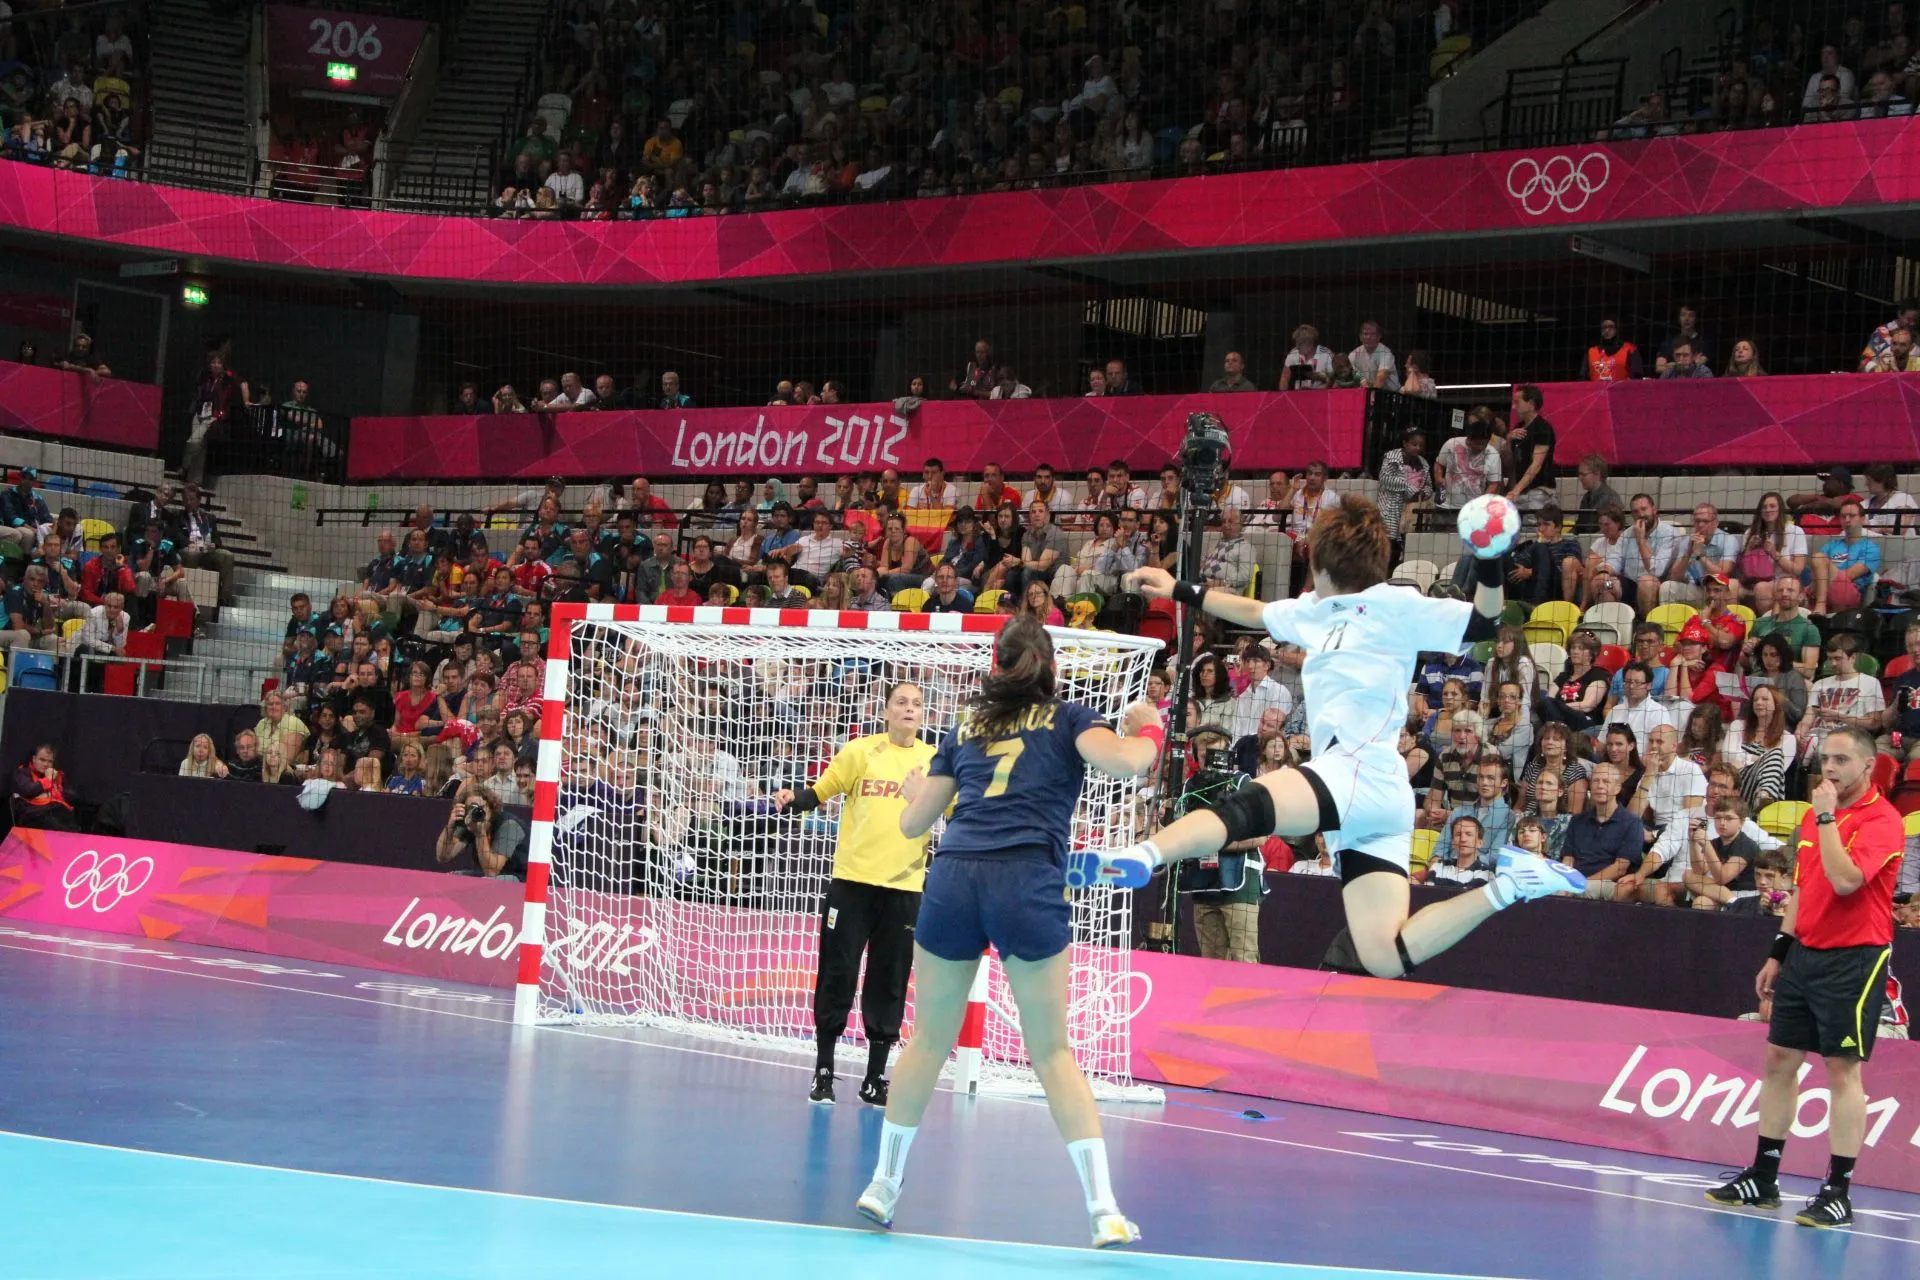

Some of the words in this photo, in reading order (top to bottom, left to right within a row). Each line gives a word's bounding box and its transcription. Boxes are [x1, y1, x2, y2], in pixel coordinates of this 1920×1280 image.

[307, 18, 383, 61] 206
[672, 414, 808, 468] London
[816, 414, 908, 466] 2012
[861, 778, 906, 799] ESPA
[985, 736, 1025, 798] 7
[541, 917, 658, 976] 2012
